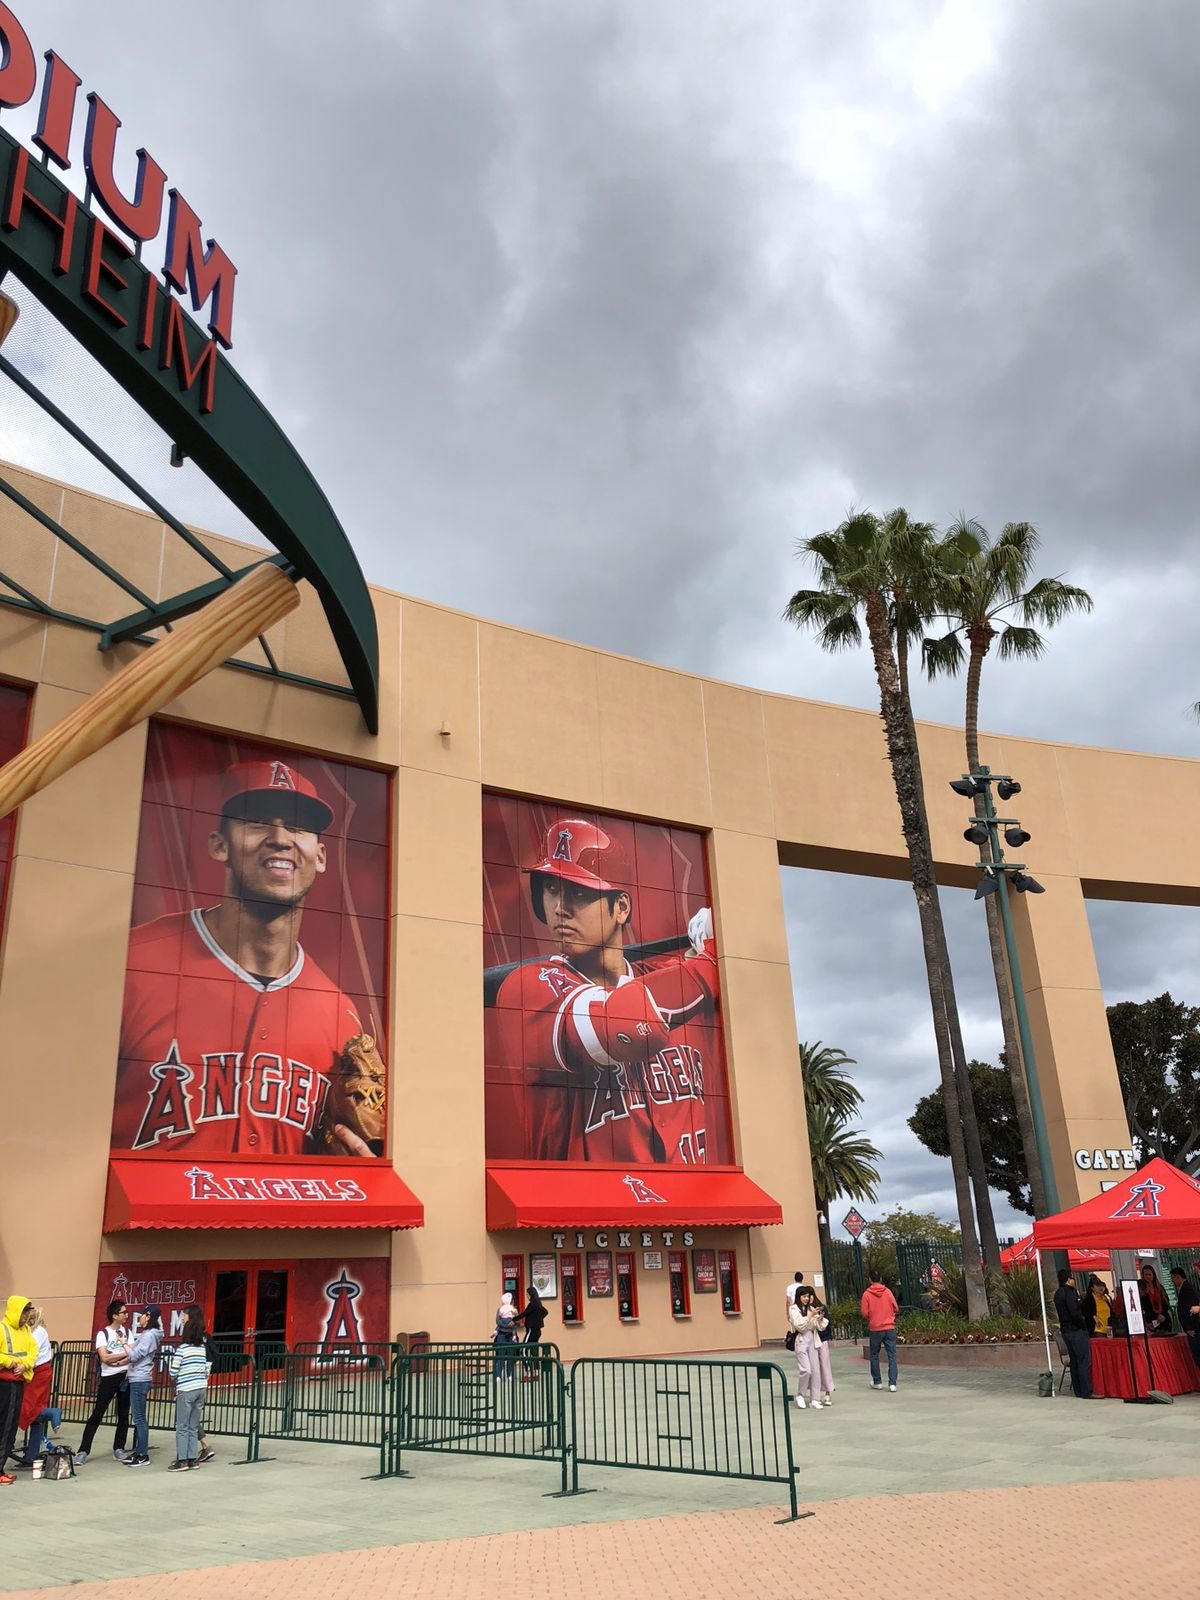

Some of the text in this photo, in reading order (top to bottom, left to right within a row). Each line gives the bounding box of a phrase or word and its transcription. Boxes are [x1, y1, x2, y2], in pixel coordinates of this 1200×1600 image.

[2, 145, 217, 414] HEIM
[1075, 1149, 1137, 1170] GATE
[184, 1166, 367, 1201] ANGELS
[553, 1231, 694, 1249] TICKETS
[109, 1272, 196, 1305] ANGELS
